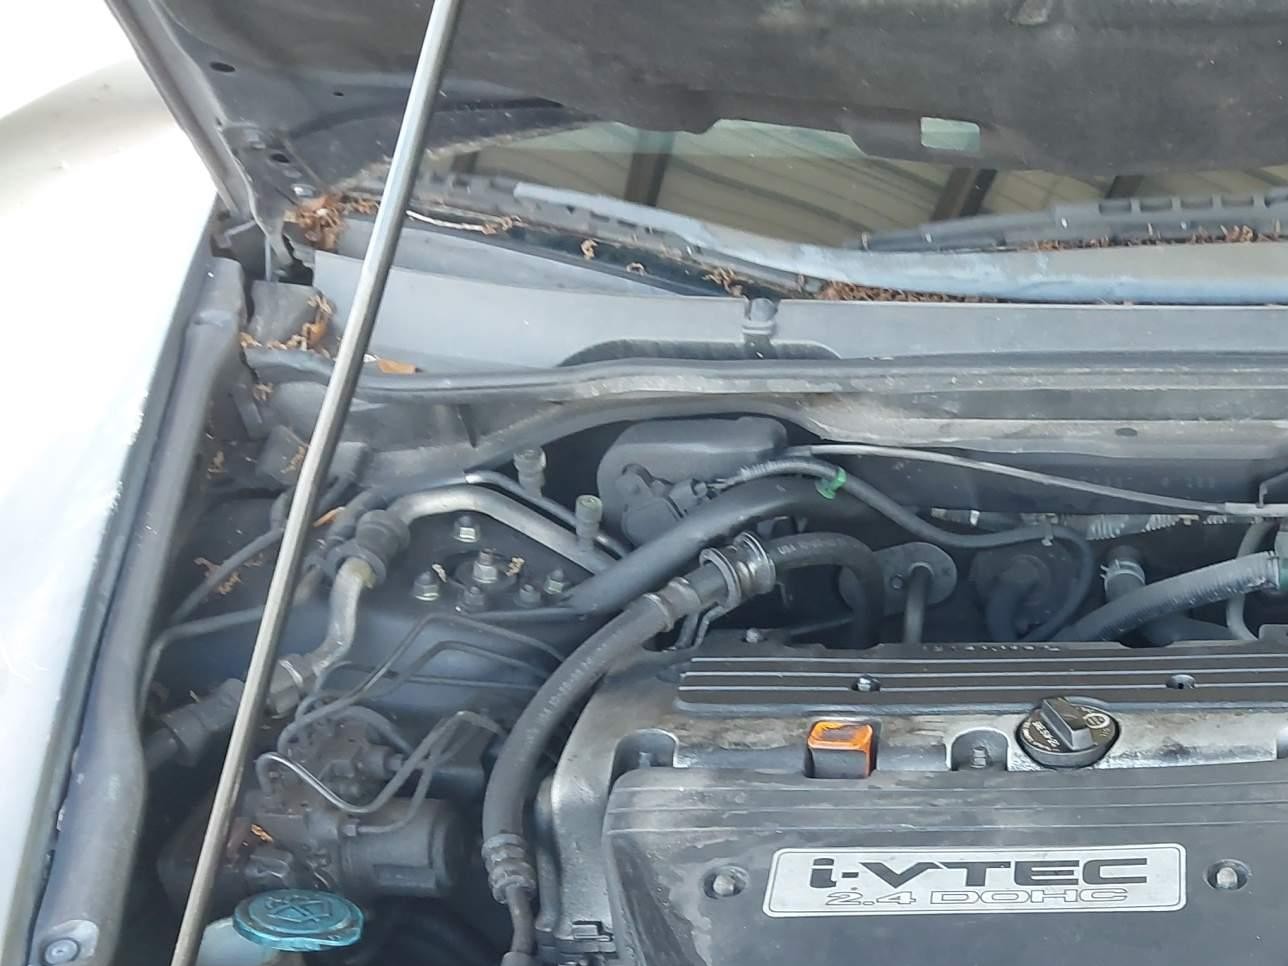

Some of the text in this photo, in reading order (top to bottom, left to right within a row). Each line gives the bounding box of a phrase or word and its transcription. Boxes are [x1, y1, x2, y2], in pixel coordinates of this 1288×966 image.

[810, 857, 1148, 888] i-VTEC
[826, 889, 1128, 906] 2.4 DOHC
